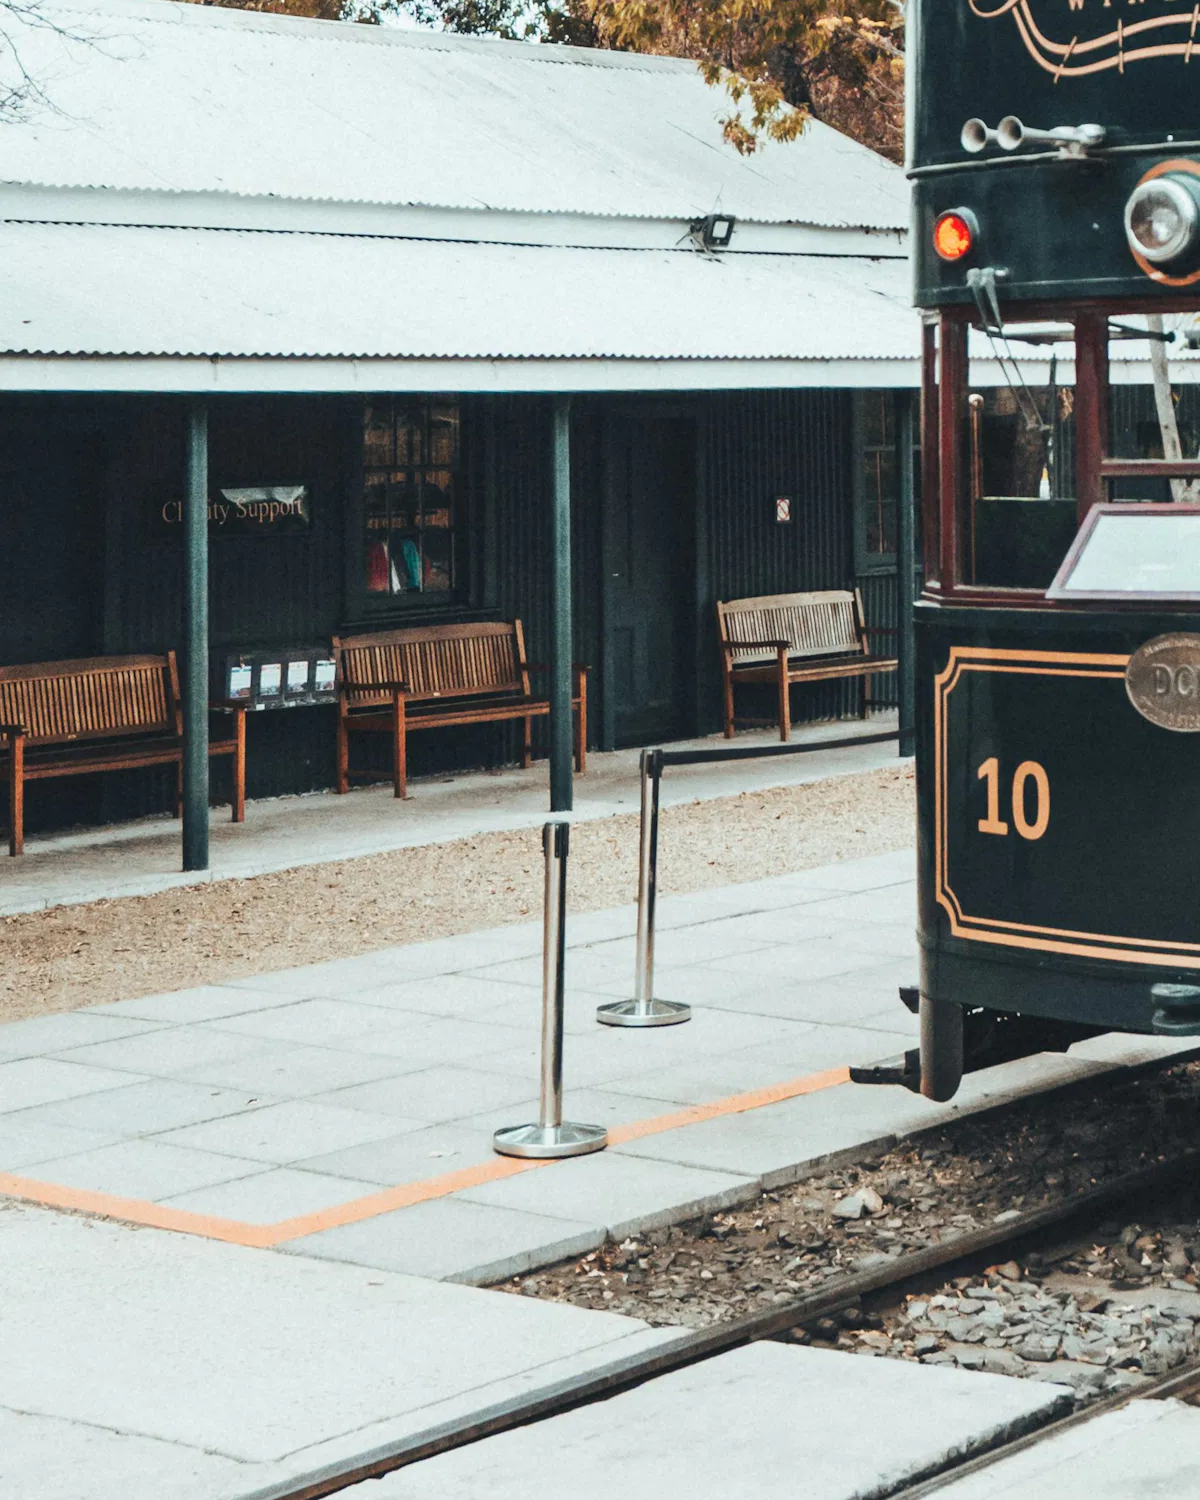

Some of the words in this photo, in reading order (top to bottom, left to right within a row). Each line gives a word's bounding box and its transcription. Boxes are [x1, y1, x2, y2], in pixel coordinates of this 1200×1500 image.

[162, 498, 230, 525] City
[236, 497, 303, 523] Support
[976, 757, 1051, 841] 10
